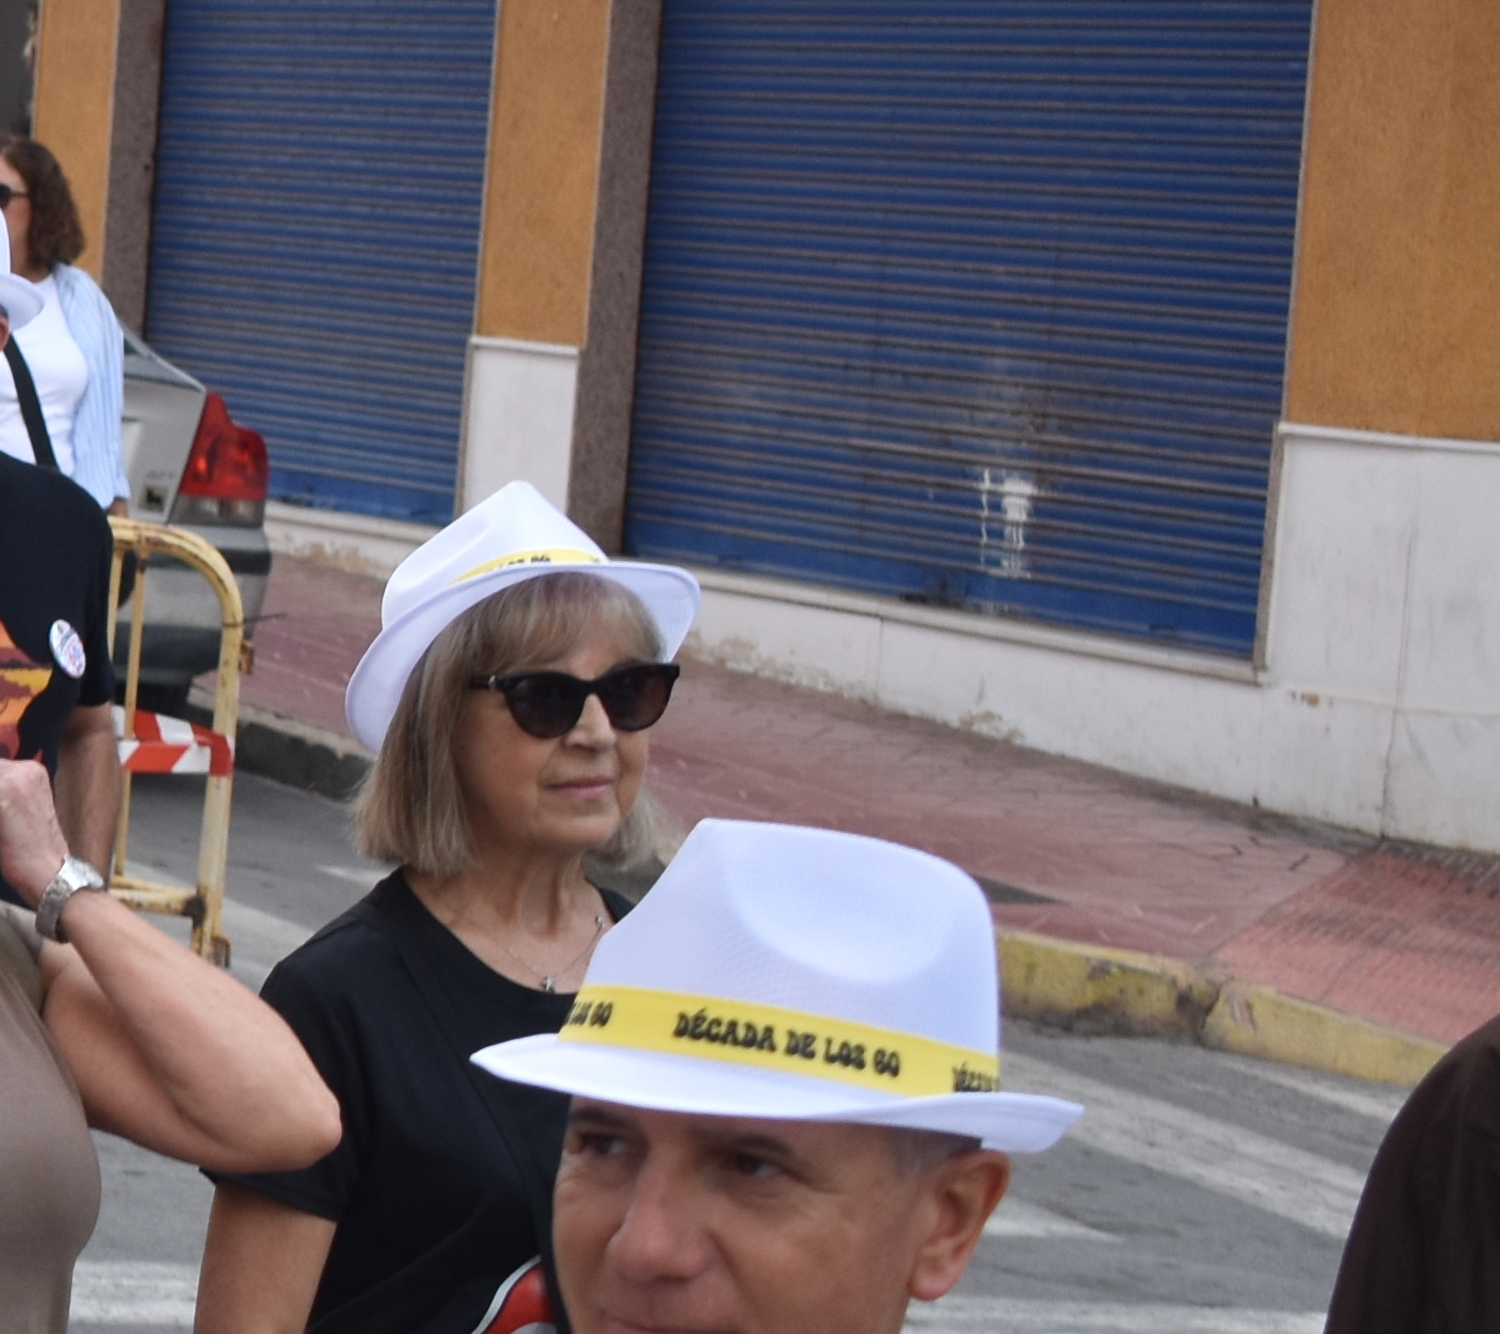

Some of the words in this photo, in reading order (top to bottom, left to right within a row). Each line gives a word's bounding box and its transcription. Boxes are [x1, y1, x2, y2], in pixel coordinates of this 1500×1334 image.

[672, 1009, 778, 1054] DÉCADA
[780, 1029, 816, 1060] DE
[821, 1037, 867, 1071] LOS
[872, 1047, 901, 1079] 60
